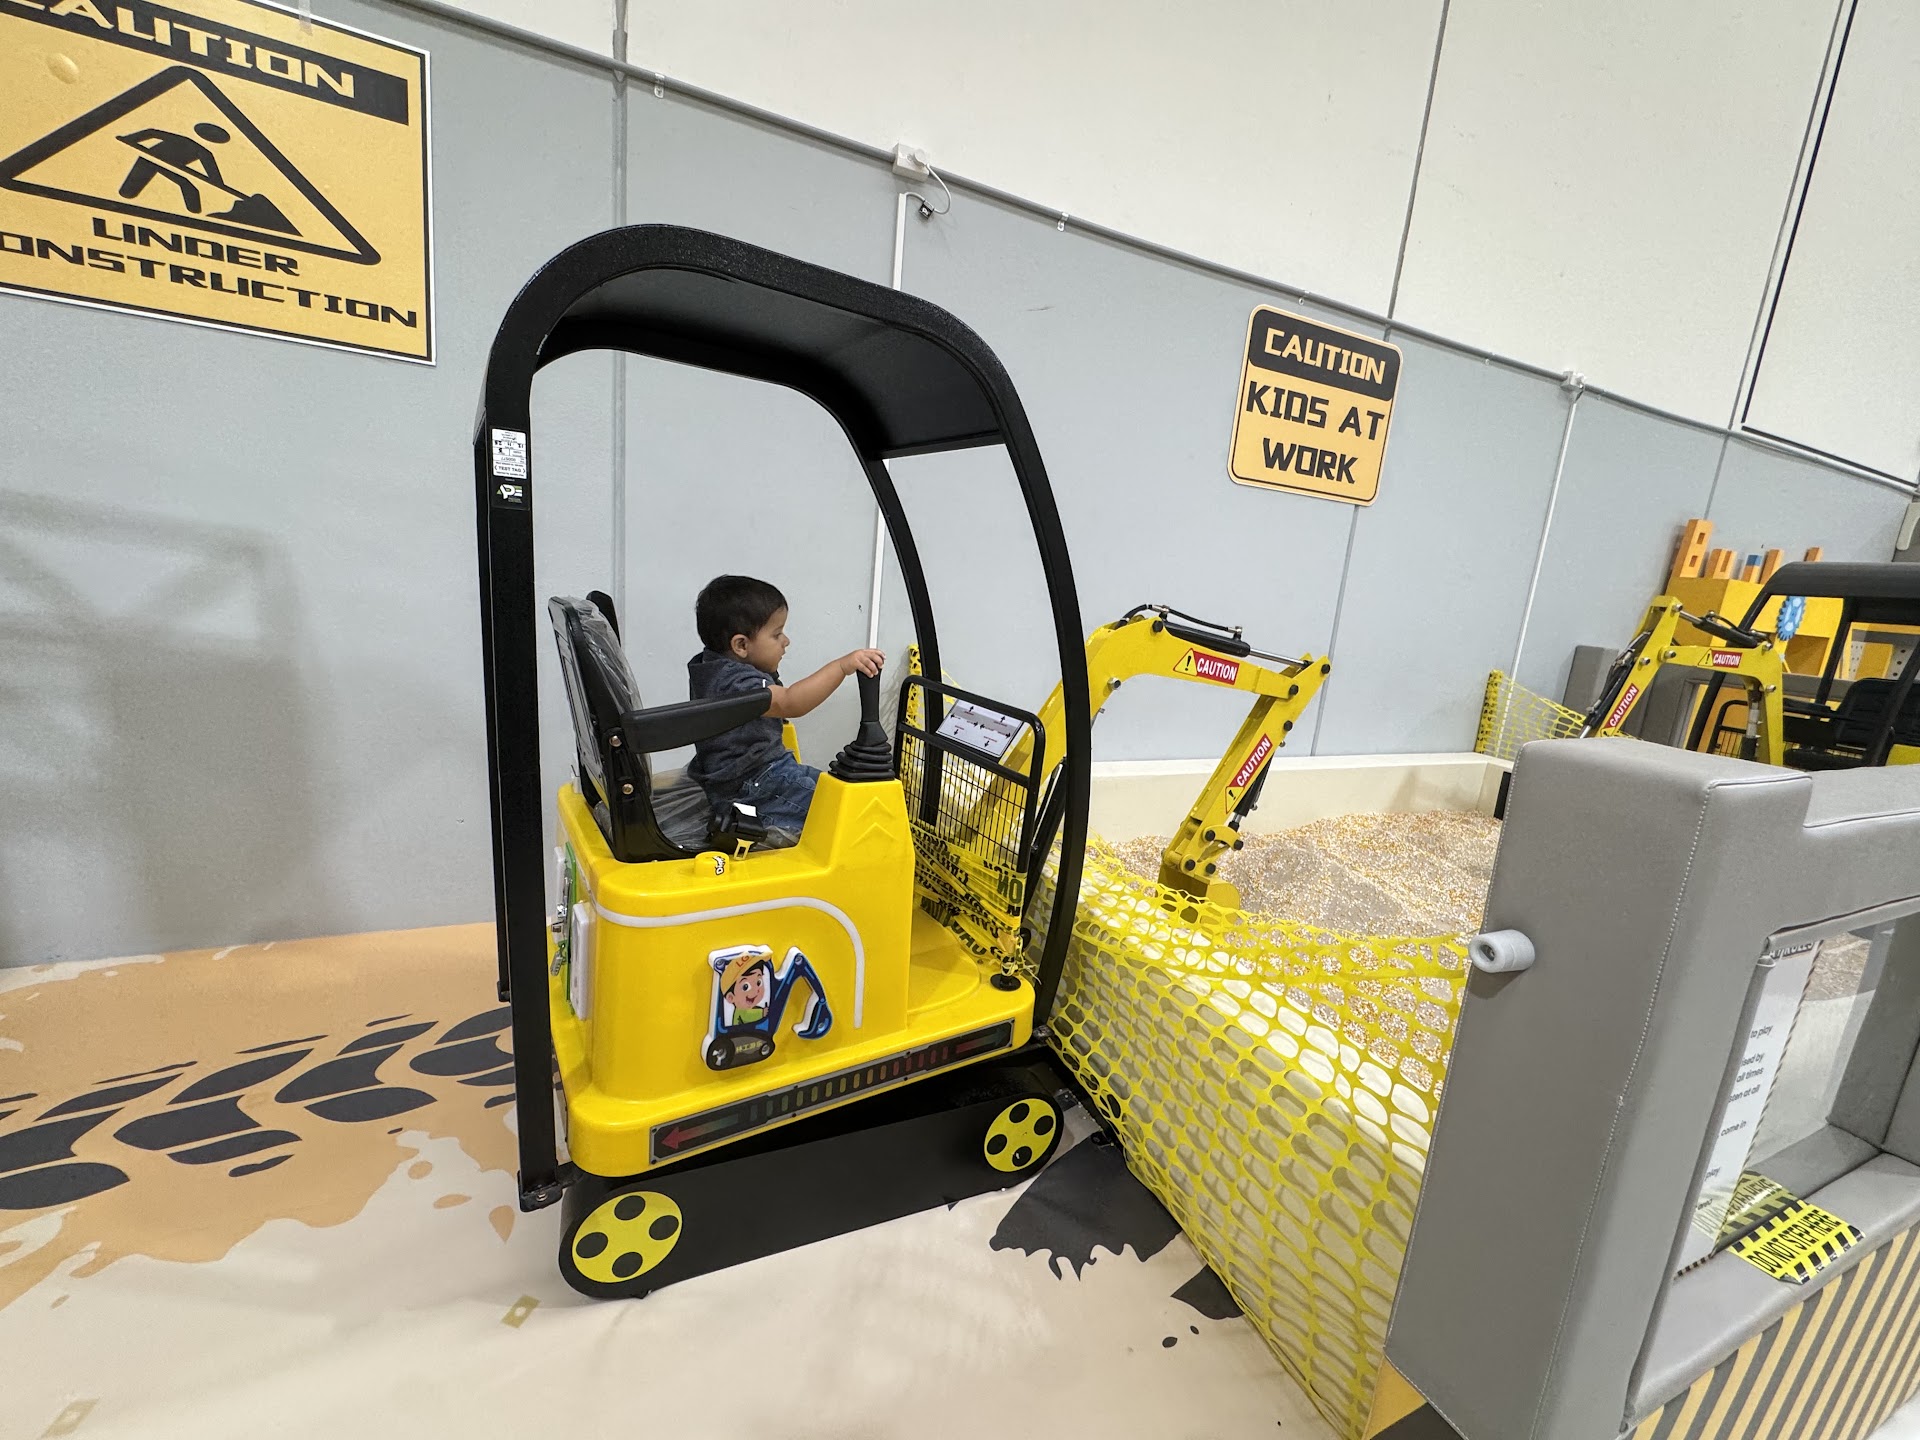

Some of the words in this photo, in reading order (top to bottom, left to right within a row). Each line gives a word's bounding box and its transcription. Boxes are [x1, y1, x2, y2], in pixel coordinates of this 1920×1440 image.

[8, 0, 355, 98] AUTION
[92, 217, 300, 276] UNDER
[1264, 327, 1386, 385] CAUTION
[1246, 380, 1330, 429] KIDS
[1338, 406, 1385, 441] AT
[1262, 437, 1358, 484] WORK
[1197, 657, 1238, 681] CAUTION
[1713, 653, 1741, 666] CAUTION
[1609, 685, 1638, 727] CAUTION
[1236, 737, 1271, 787] CAUTION
[735, 955, 750, 968] LG
[1757, 1025, 1773, 1039] play
[1755, 1052, 1765, 1064] by
[1736, 1071, 1747, 1082] all
[1746, 1067, 1764, 1080] times
[1778, 1224, 1819, 1250] STEP
[1797, 1209, 1842, 1237] HERE
[1747, 1251, 1783, 1274] DO
[1760, 1237, 1800, 1265] NOT
